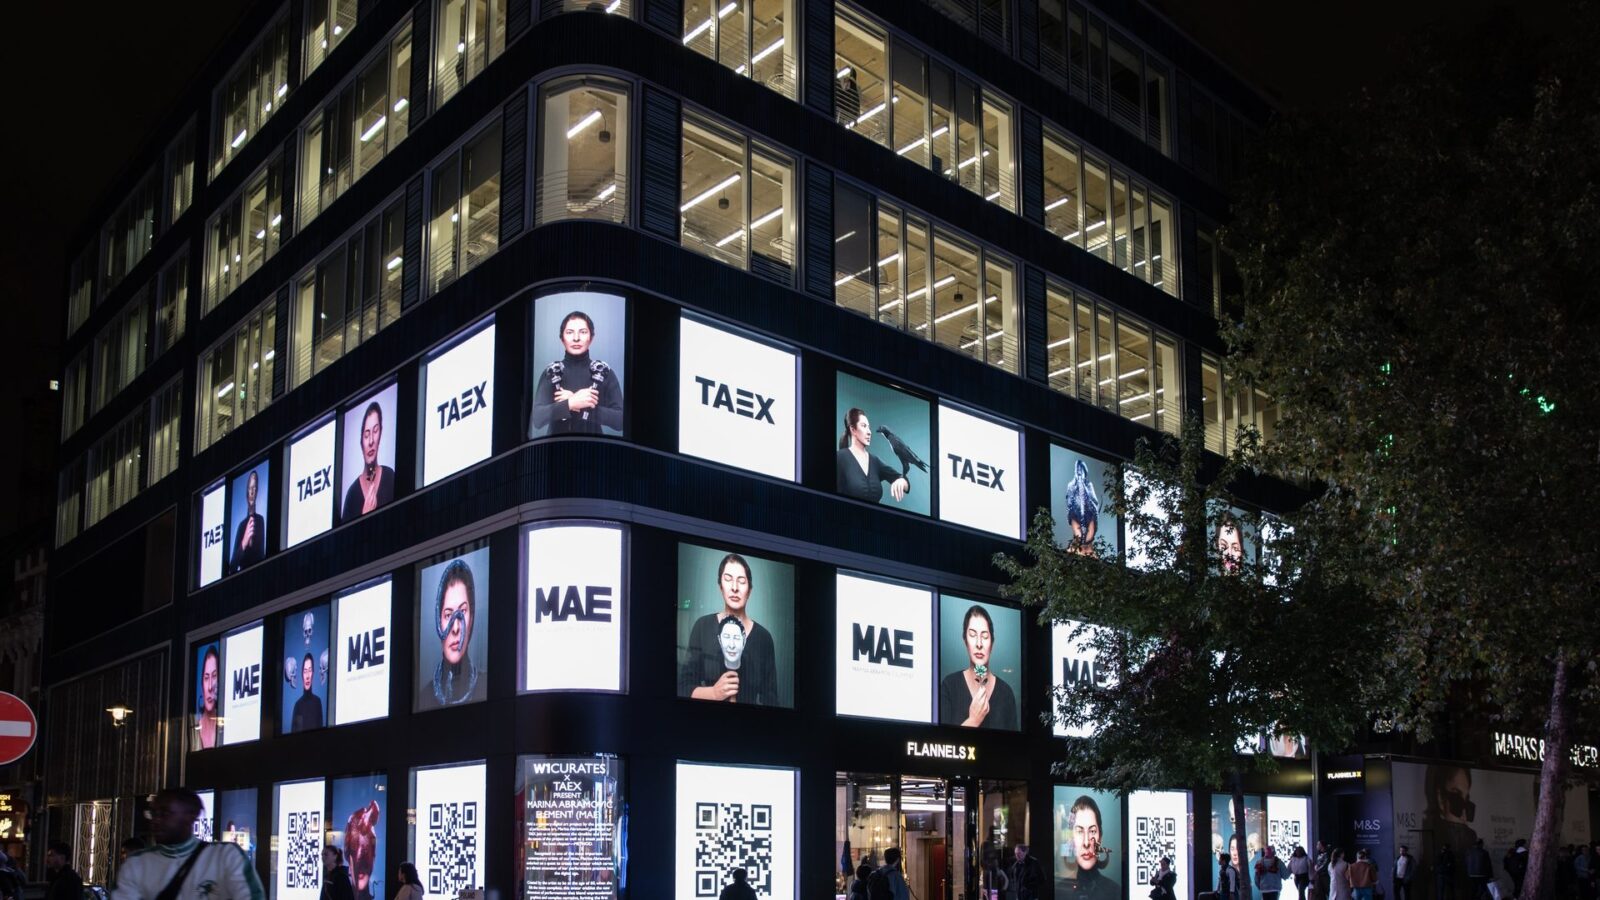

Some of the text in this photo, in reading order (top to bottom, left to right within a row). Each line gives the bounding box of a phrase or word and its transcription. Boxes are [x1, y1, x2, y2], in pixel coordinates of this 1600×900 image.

[437, 380, 487, 430] TAEX
[695, 375, 775, 425] TAEX
[297, 464, 332, 502] TAEX
[947, 452, 1005, 492] TAEX
[535, 585, 612, 624] MAE
[347, 626, 385, 673] MAE
[852, 622, 914, 669] MAE
[233, 663, 260, 701] MAE
[907, 741, 976, 760] FLANNELS X
[1495, 731, 1538, 761] MARKS
[533, 763, 606, 774] W1CURATES
[553, 781, 582, 791] TAEX
[527, 800, 557, 809] MARINA
[536, 810, 573, 819] ELEMENT
[1396, 811, 1416, 828] M&S
[1354, 819, 1381, 831] M&S
